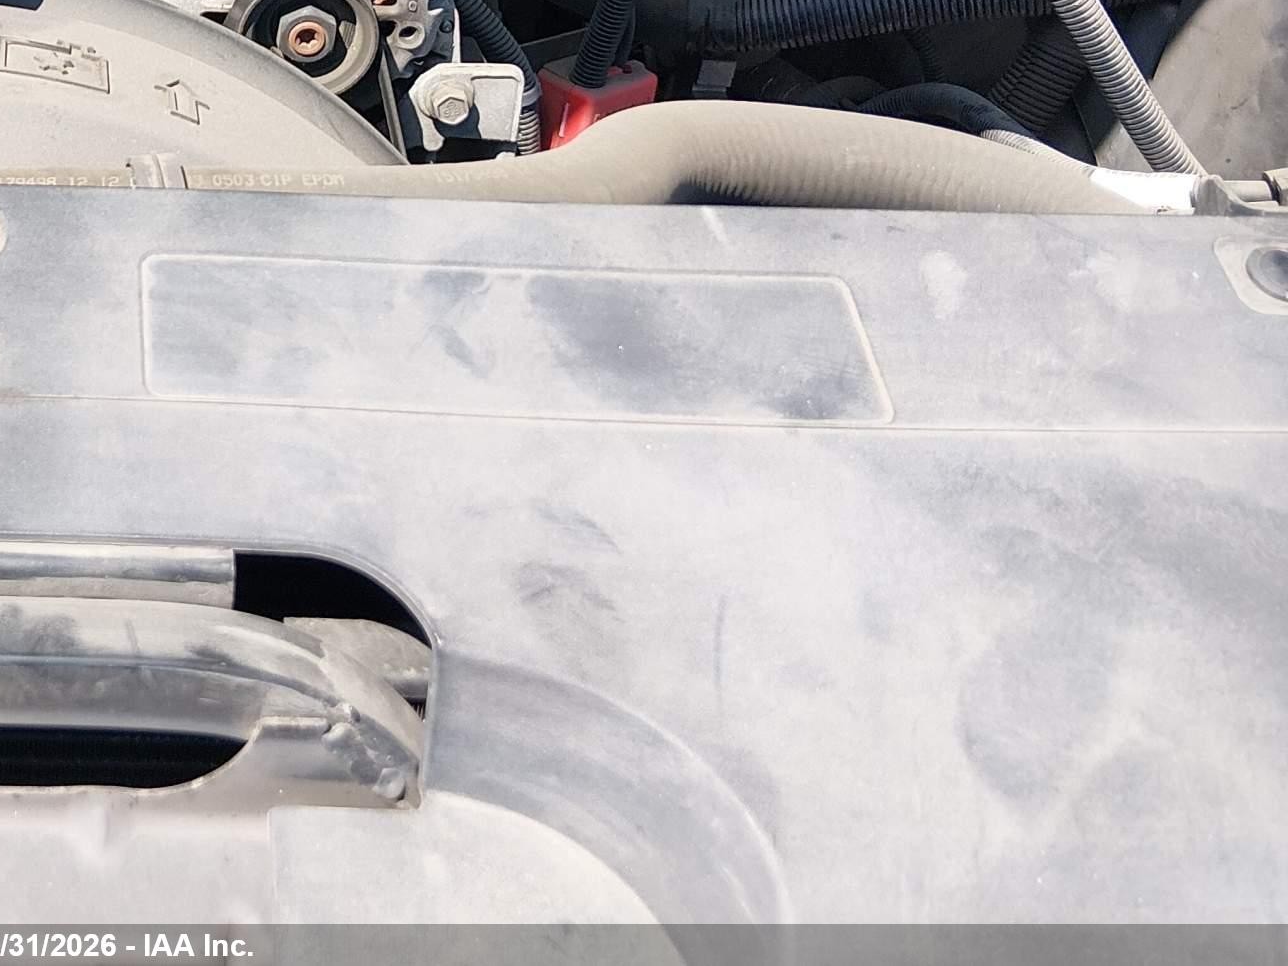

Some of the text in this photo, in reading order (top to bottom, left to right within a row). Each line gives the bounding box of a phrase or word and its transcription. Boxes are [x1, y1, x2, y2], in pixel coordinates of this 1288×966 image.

[212, 175, 255, 187] 0503
[263, 175, 292, 187] CIP
[302, 175, 345, 187] EPDM
